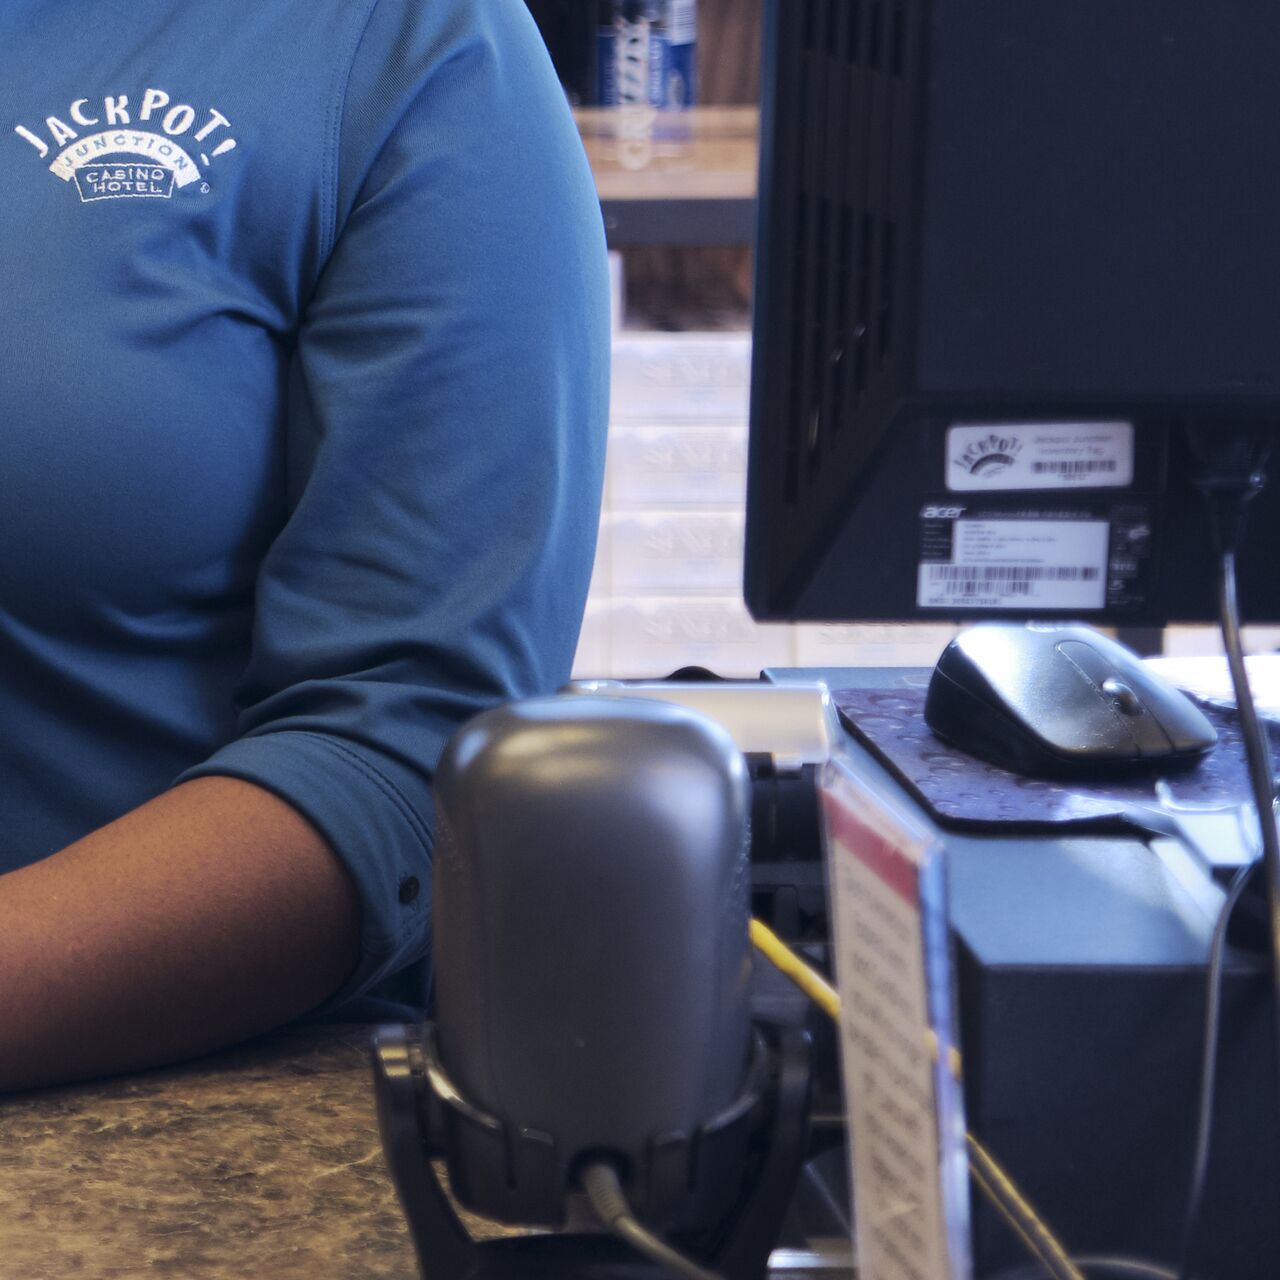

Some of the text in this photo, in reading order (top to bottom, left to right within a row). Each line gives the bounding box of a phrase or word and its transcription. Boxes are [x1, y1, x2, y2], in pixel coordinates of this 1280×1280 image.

[14, 88, 237, 168] JACKPOT!
[63, 133, 189, 171] JUNCTION
[85, 169, 165, 184] CASINO
[92, 181, 162, 194] HOTEL
[923, 506, 966, 519] acer
